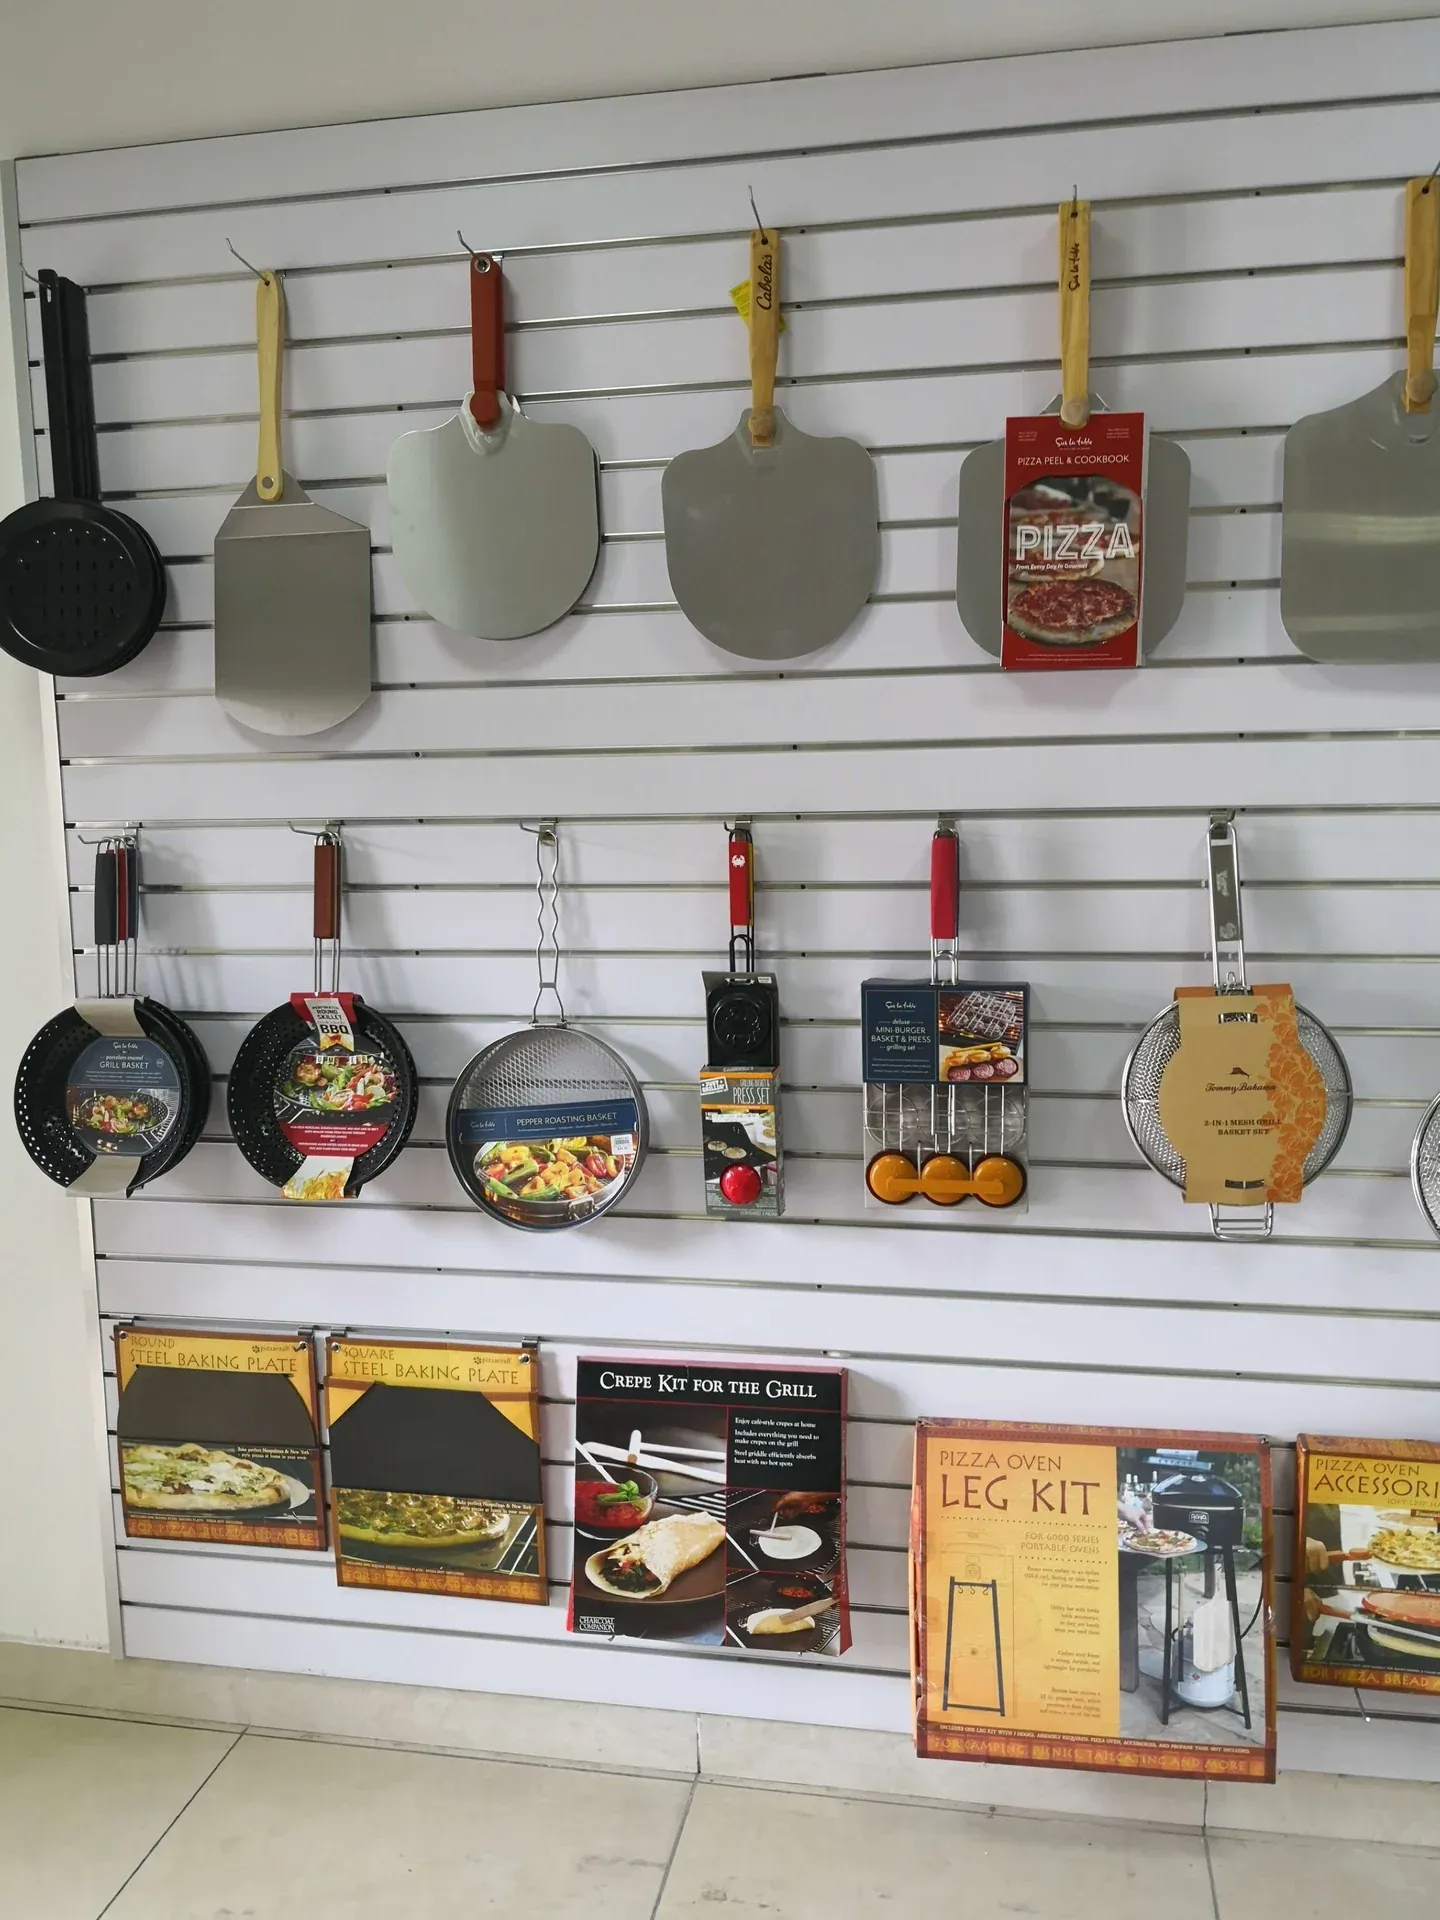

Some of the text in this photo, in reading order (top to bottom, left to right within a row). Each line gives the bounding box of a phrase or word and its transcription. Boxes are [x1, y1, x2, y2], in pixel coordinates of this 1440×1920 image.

[756, 254, 772, 311] Cabela's
[1017, 454, 1130, 466] PIZZA PEEL & COOKBOOK
[1016, 523, 1135, 560] PIZZA
[320, 1025, 349, 1034] BBQ
[875, 1026, 926, 1034] MINI-BURGER
[886, 1043, 906, 1052] grilling
[99, 1061, 120, 1069] GRILL
[121, 1061, 149, 1069] BASKET
[1205, 1081, 1276, 1095] Tommy Bahama
[732, 1087, 770, 1105] PRESS SET
[517, 1112, 617, 1126] PEPPER ROASTING BASKET
[131, 1336, 175, 1349] ROUND
[344, 1346, 395, 1360] SQUARE
[131, 1349, 298, 1372] STEEL BAKING PLATE
[344, 1360, 519, 1385] STEEL BAKING PLATE
[693, 1379, 724, 1393] FOR
[727, 1381, 760, 1395] THE
[735, 1416, 750, 1425] Enjoy
[956, 1420, 1014, 1430] PIZZA
[1020, 1424, 1071, 1433] OVEN
[734, 1429, 757, 1437] Includes
[758, 1431, 786, 1439] everything
[748, 1450, 767, 1458] griddle
[768, 1451, 795, 1459] efficiently
[940, 1450, 1062, 1471] PIZZA OVEN
[1316, 1458, 1420, 1476] PIZZA OVEN
[942, 1473, 1101, 1515] LEG KIT
[131, 1523, 313, 1542] FOR PIZZA, BREAD AND MORE
[1025, 1532, 1099, 1544] FOR 6000 SERIES
[1021, 1541, 1100, 1554] PORTABLE OVENS
[346, 1570, 537, 1597] FOR PIZZA, BREAD AND MORE
[579, 1616, 615, 1624] CHARCOAL
[579, 1623, 615, 1633] COMPANION
[1303, 1666, 1328, 1678] FOR
[1334, 1668, 1380, 1684] PIZZA,
[1384, 1672, 1429, 1687] BREAD
[933, 1736, 961, 1749] FOR
[964, 1739, 1029, 1757] CAMPING,
[1087, 1749, 1165, 1765] TAILGATING
[1169, 1755, 1201, 1768] AND
[1204, 1758, 1248, 1771] MORE
